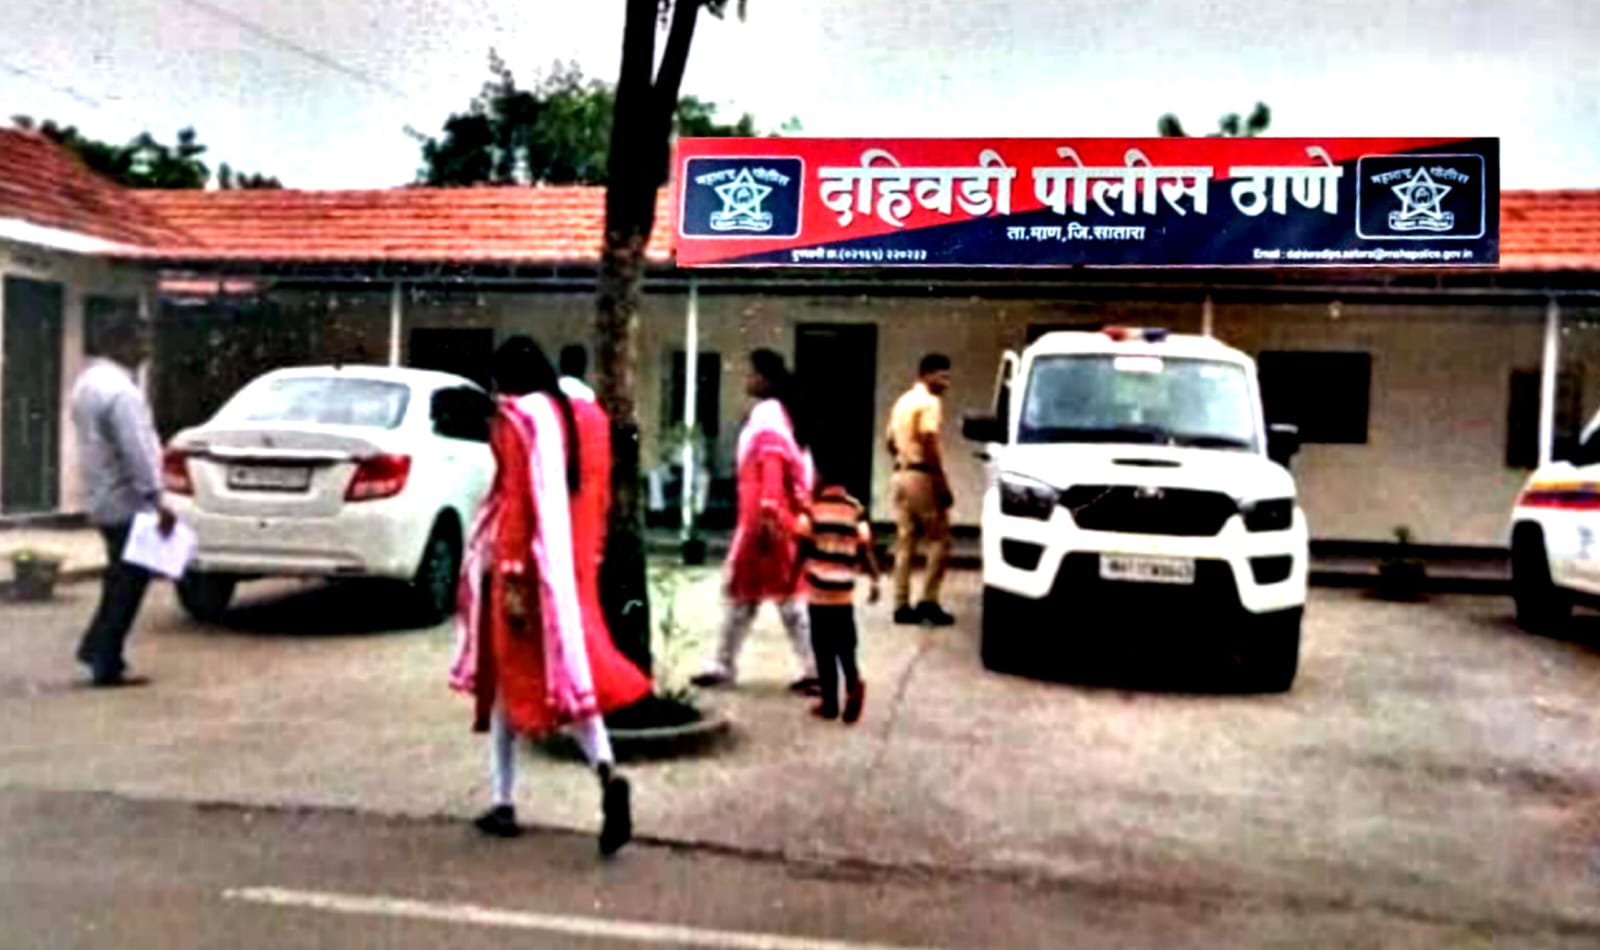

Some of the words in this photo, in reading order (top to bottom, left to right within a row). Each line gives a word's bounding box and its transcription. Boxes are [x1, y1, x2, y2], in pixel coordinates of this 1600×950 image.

[818, 149, 1017, 227] दहिवडी
[1032, 146, 1214, 217] पोलीस
[1229, 146, 1344, 217] ठाणे
